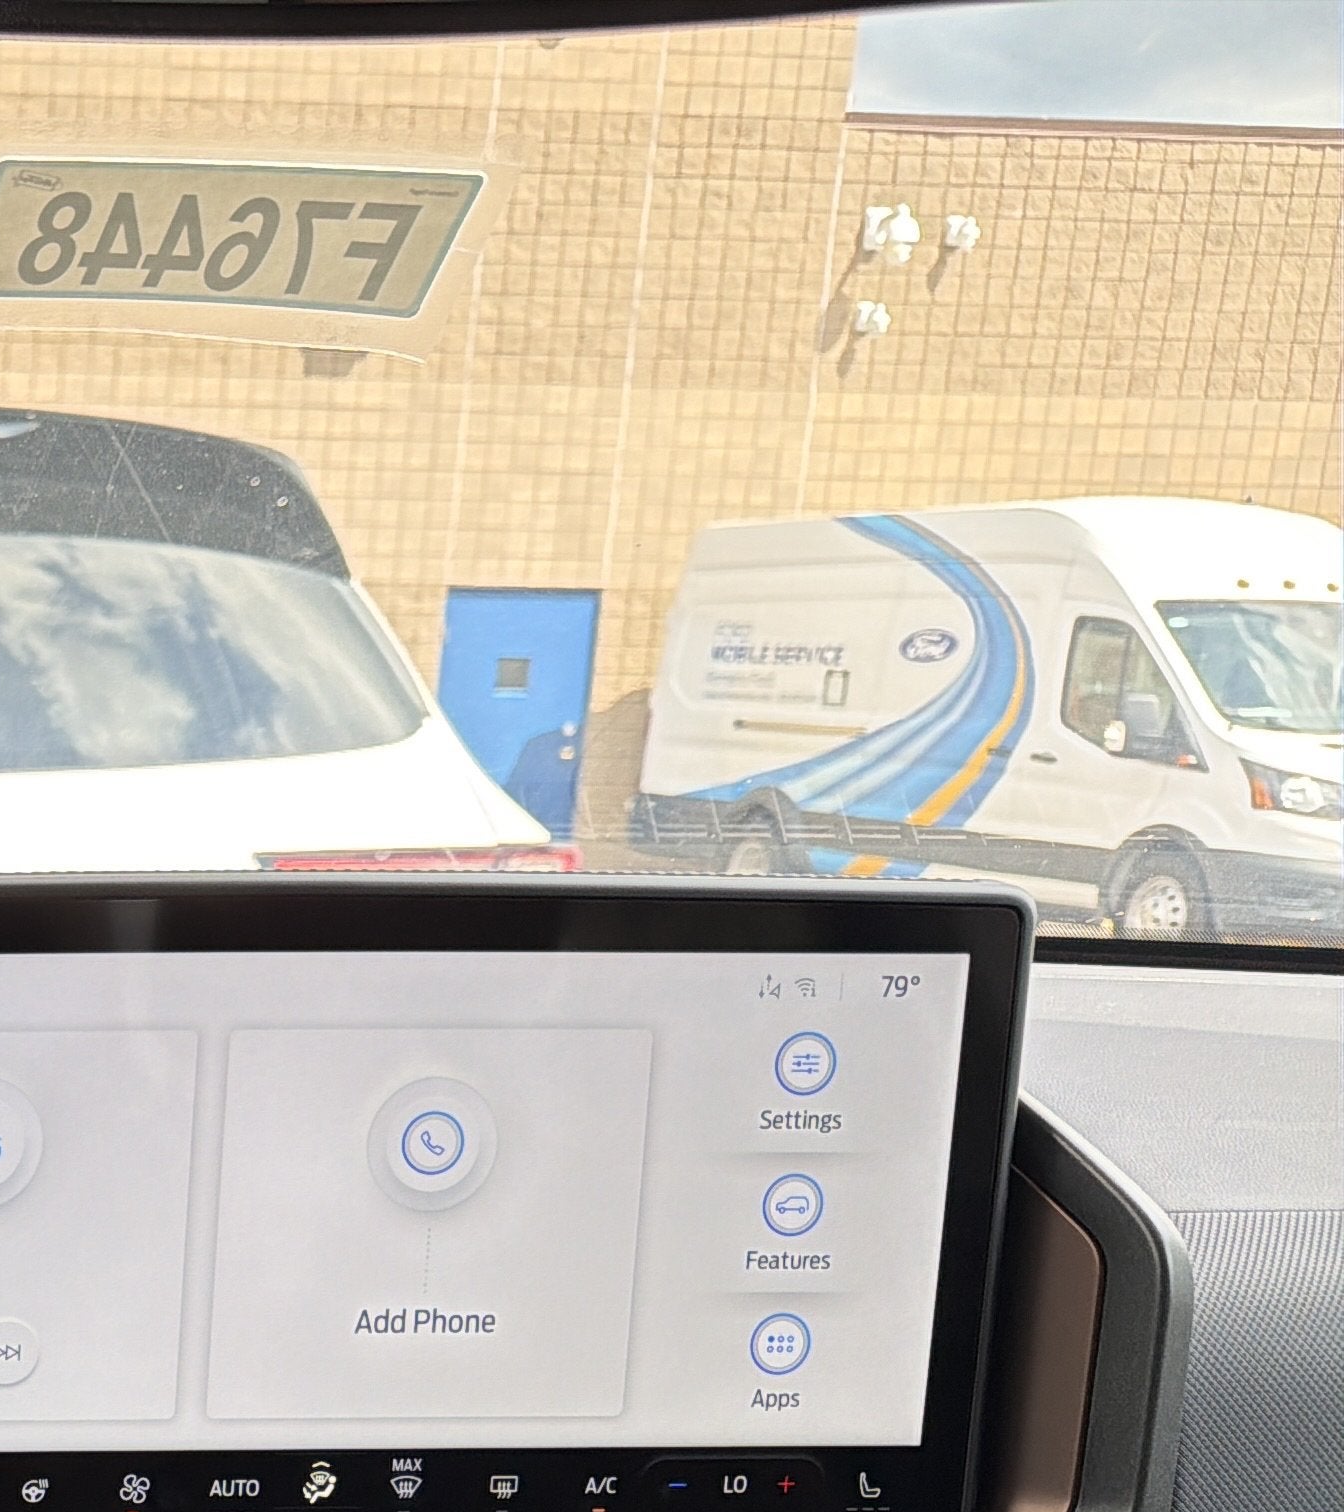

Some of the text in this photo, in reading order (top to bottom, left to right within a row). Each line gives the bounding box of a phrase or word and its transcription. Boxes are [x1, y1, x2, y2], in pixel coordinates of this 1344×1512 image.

[881, 975, 921, 998] 79°
[759, 1109, 842, 1134] Settings
[745, 1250, 831, 1270] Features
[354, 1308, 496, 1334] Add Phone
[750, 1388, 801, 1411] Apps
[391, 1458, 423, 1473] MAX
[209, 1479, 261, 1498] AUTO
[584, 1475, 618, 1495] A/C
[723, 1475, 748, 1494] LO
